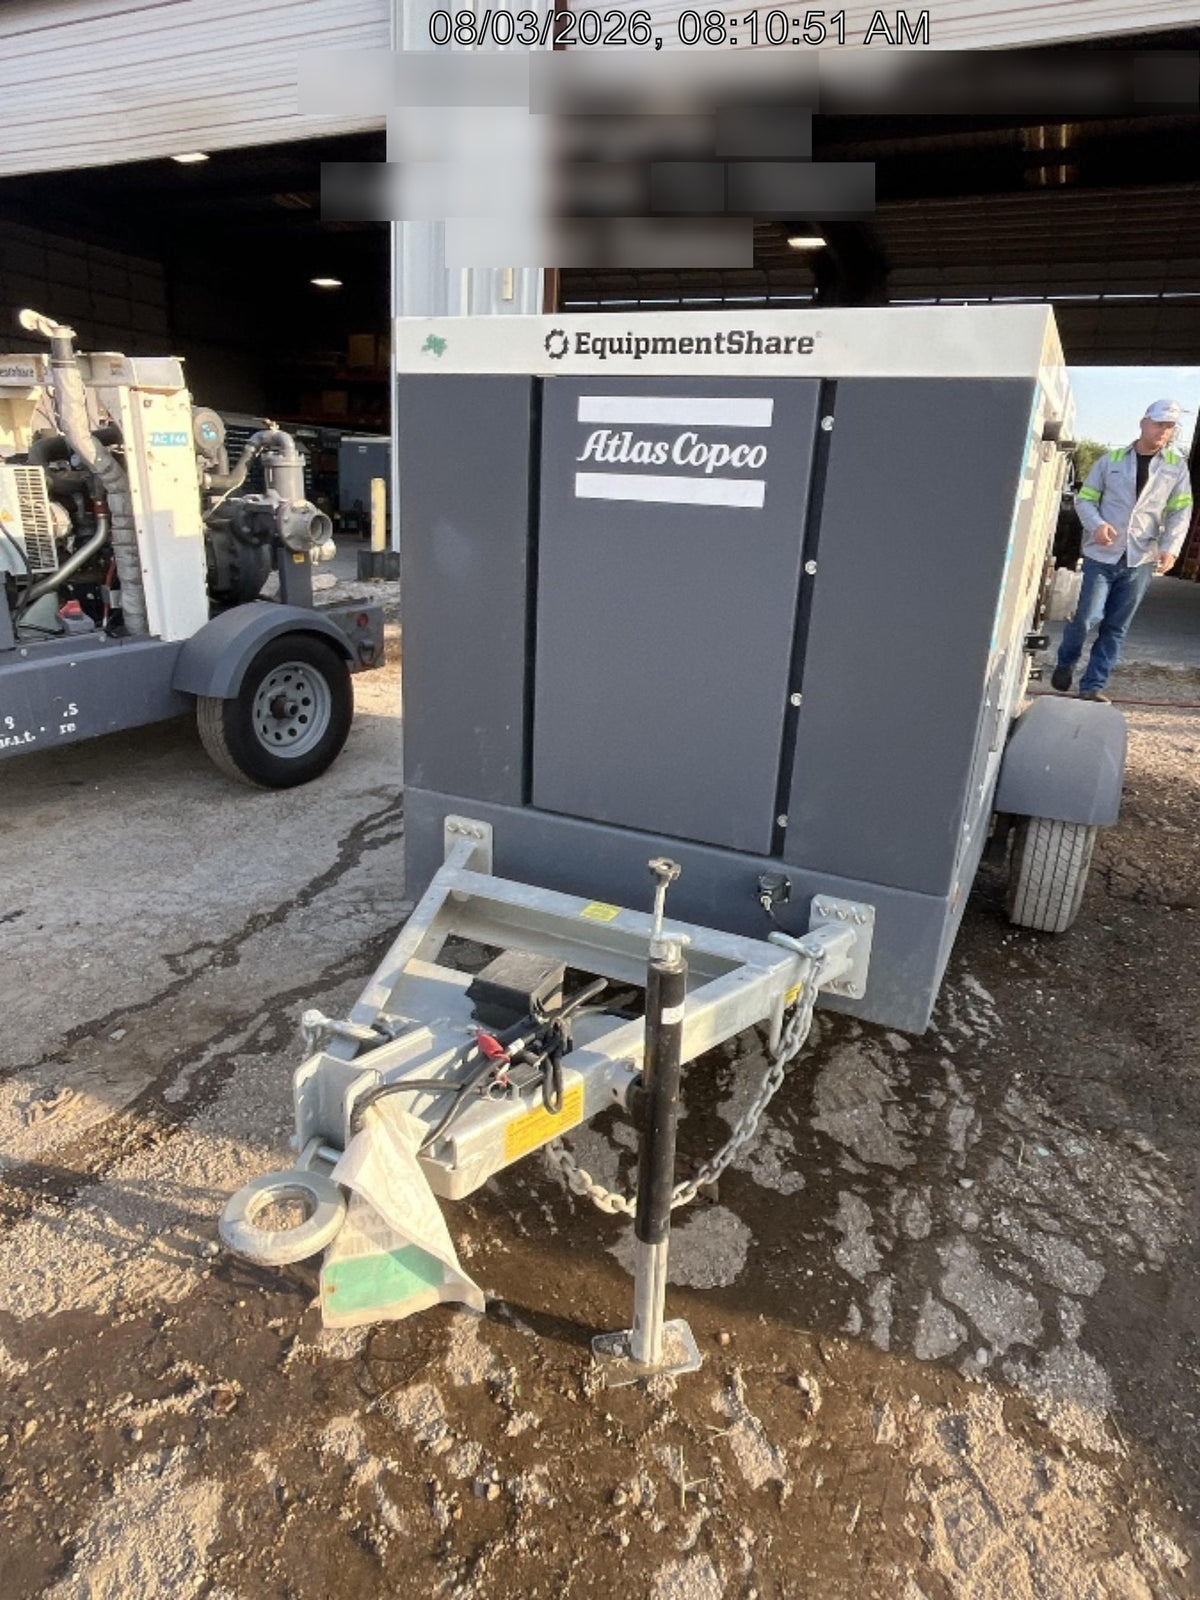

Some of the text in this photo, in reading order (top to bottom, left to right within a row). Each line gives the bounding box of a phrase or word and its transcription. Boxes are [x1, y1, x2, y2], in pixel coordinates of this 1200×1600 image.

[575, 330, 815, 359] EquipmentShare
[576, 430, 767, 473] Atlas Copco
